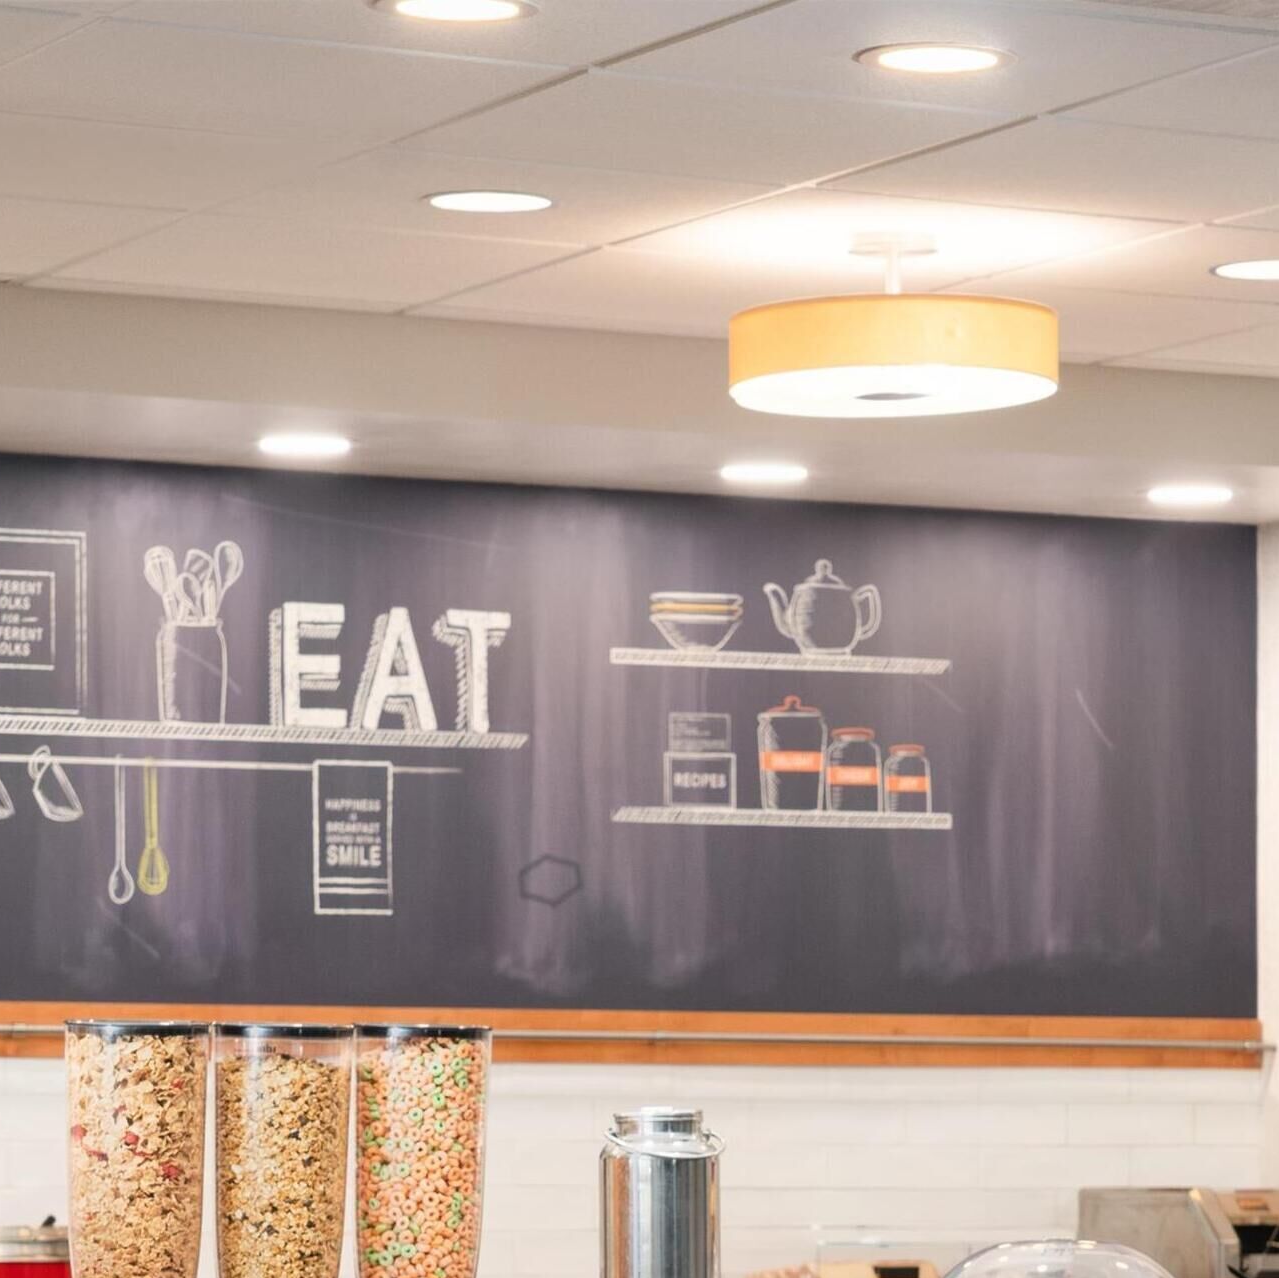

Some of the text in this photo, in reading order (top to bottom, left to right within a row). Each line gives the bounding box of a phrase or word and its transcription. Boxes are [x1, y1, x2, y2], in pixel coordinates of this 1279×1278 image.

[269, 601, 512, 733] EAT
[673, 772, 727, 789] RECIPES
[324, 798, 382, 812] HAPPINESS
[326, 845, 382, 866] SMILE
